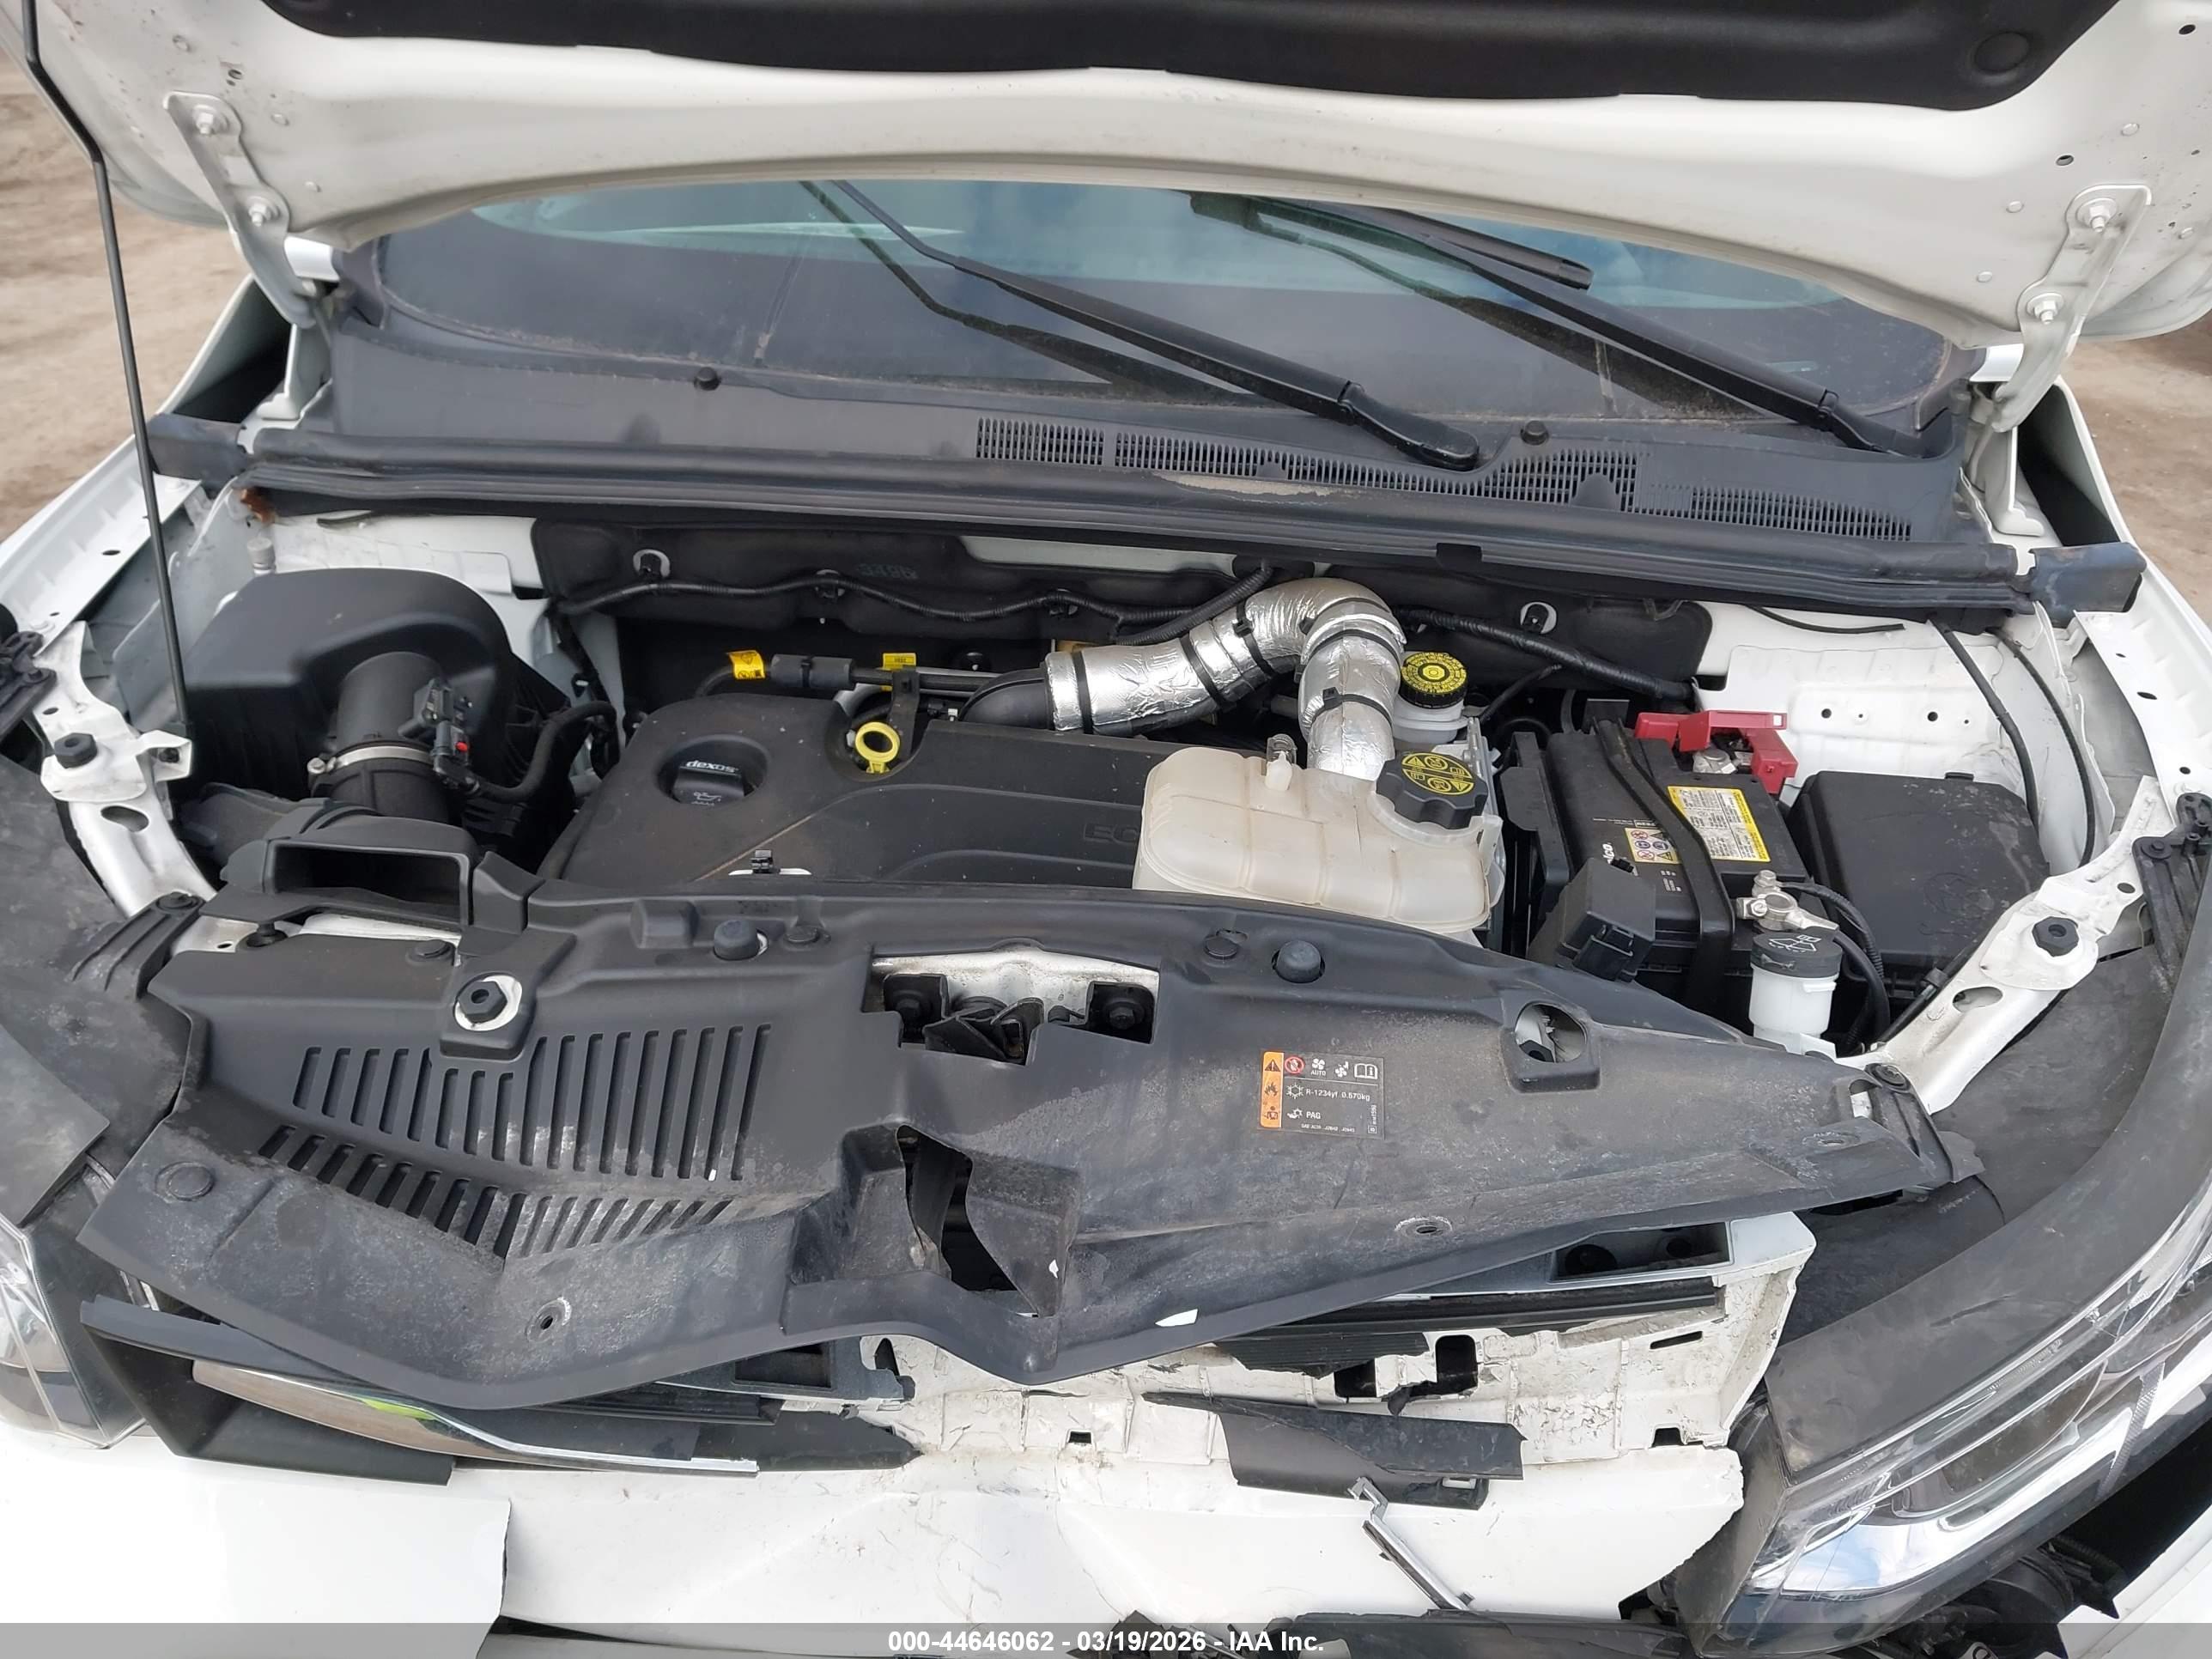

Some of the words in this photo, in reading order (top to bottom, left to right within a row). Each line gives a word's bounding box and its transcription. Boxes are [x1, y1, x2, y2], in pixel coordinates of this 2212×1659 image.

[685, 760, 736, 773] dexos
[1305, 1088, 1338, 1100] R-1234yf
[1306, 1110, 1322, 1120] PAG
